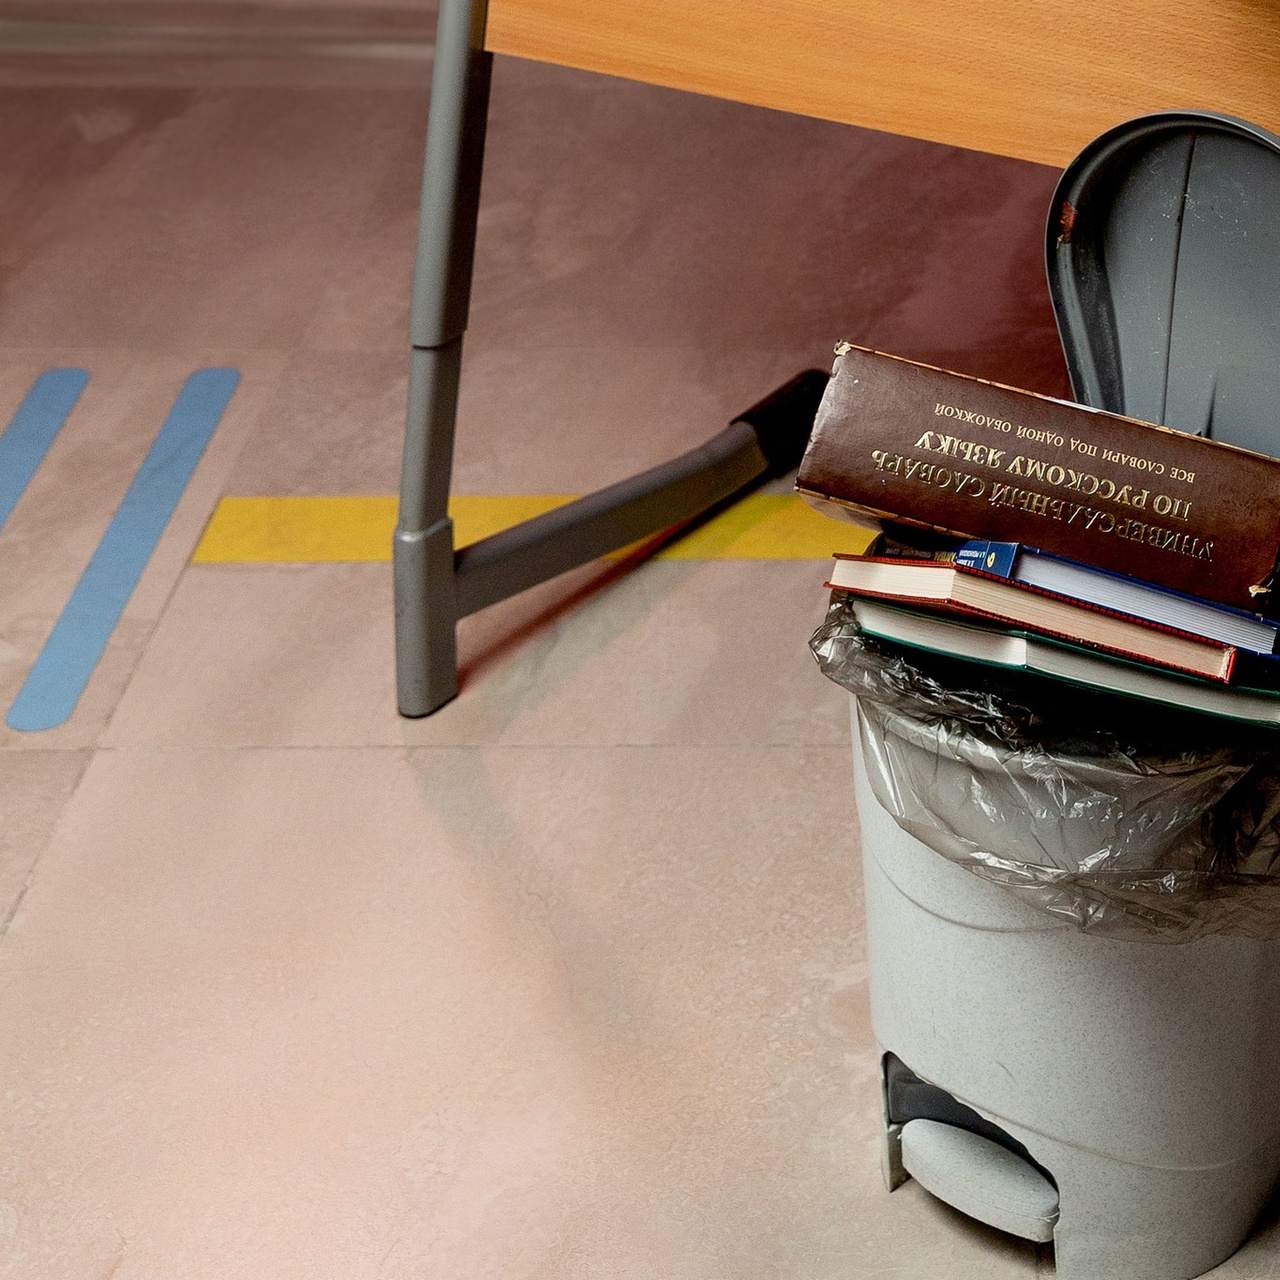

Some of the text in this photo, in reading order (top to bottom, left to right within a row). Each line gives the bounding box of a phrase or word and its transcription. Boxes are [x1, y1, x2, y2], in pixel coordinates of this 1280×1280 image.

[913, 426, 1193, 521] ПО РУССКОМУ ЯЗЫКУ
[933, 401, 1196, 482] ВСЕ СЛОВАРИ ПОД ОДНОЙ ОБЛОЖКОЙ
[868, 447, 1216, 563] УНИВЕРСАЛЬНЫЙ СЛОВАРЬ
